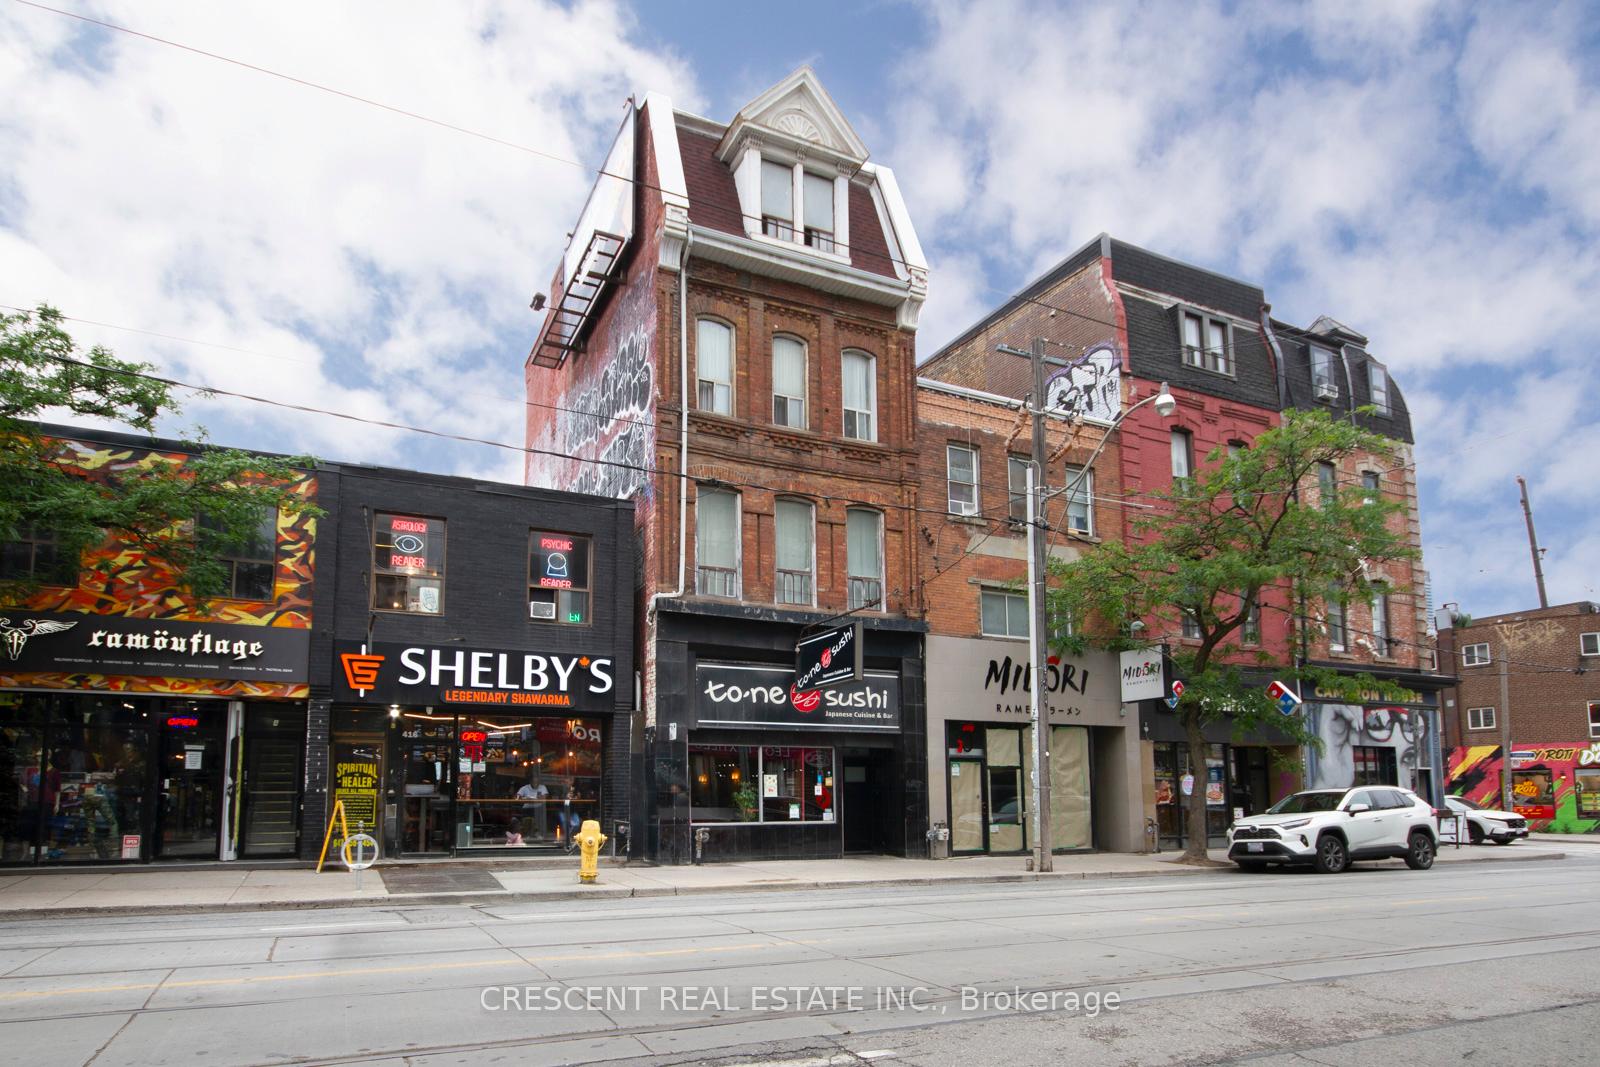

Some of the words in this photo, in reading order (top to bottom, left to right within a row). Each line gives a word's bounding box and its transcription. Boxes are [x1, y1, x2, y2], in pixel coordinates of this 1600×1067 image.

[392, 520, 427, 533] ASTROLOGY
[541, 538, 573, 551] PSYCHIC
[392, 555, 425, 568] READER
[540, 577, 572, 589] READER
[831, 627, 853, 656] sushi
[445, 690, 508, 703] LEGENDARY
[511, 693, 570, 706] SHAWARMA
[824, 686, 888, 709] sushi
[167, 718, 198, 727] OPEN
[462, 732, 486, 741] OPEN
[337, 763, 377, 778] SPIRITUAL
[341, 777, 372, 788] HEALER
